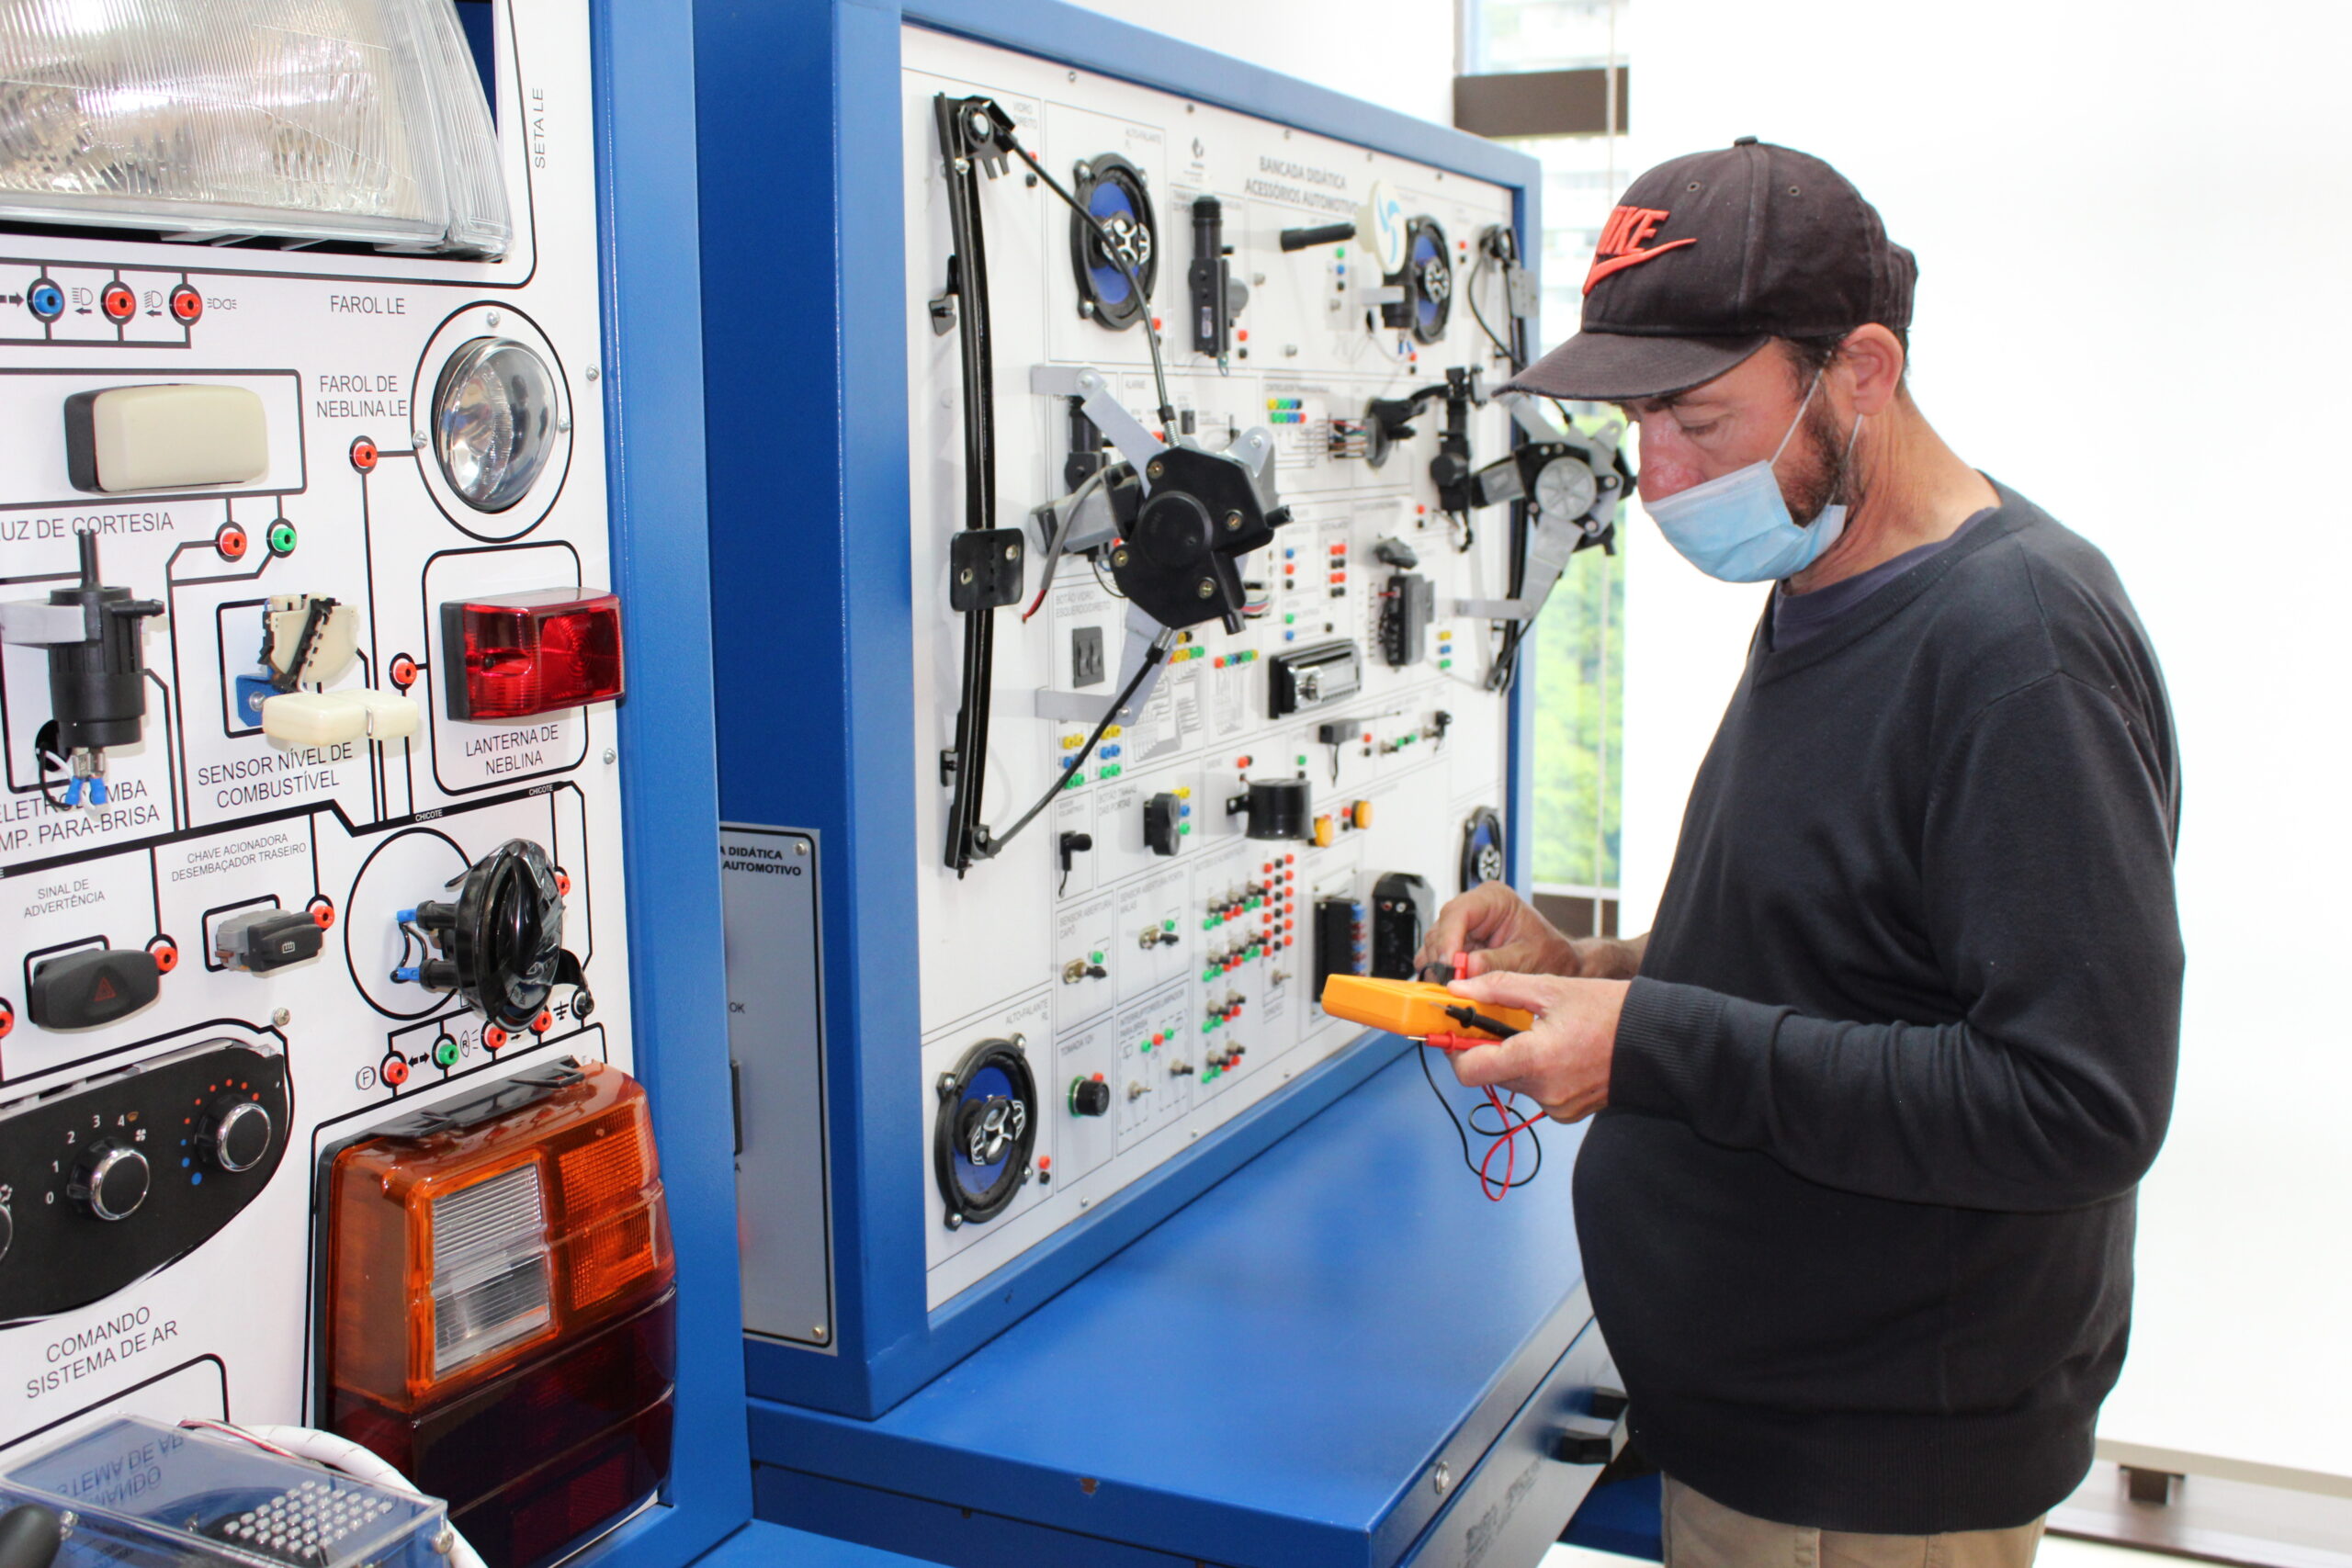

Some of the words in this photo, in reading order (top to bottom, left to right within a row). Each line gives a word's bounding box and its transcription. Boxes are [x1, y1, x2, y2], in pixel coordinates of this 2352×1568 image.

[532, 88, 544, 112] LE
[534, 118, 546, 168] SETA
[1260, 155, 1304, 179] BANCADA
[1303, 190, 1359, 213] AUTOMOTIVO
[330, 295, 383, 314] FAROL
[387, 297, 406, 315] LE
[320, 375, 372, 393] FAROL
[377, 375, 398, 392] DE
[316, 400, 386, 418] NEBLINA
[390, 400, 408, 416] LE
[0, 521, 30, 542] UZ
[37, 518, 65, 543] DE
[72, 512, 175, 536] CORTESIA
[466, 728, 538, 757] LANTERNA
[541, 724, 560, 742] DE
[198, 756, 274, 786] SENSOR
[277, 746, 327, 772] NÍVEL
[331, 741, 353, 761] DE
[485, 750, 544, 776] NEBLINA
[217, 769, 340, 808] COMBUSTÍVEL
[528, 784, 554, 796] CHICOTE
[415, 808, 443, 822] CHICOTE
[0, 829, 31, 853] MP.
[39, 804, 161, 845] PARA-BRISA
[187, 846, 221, 864] CHAVE
[223, 833, 288, 854] ACIONADORA
[729, 846, 783, 861] DIDÁTICA
[171, 852, 256, 882] DESEMBAÇADOR
[258, 842, 307, 862] TRASEIRO
[722, 860, 802, 876] AUTOMOTIVO
[38, 883, 71, 900] SINAL
[74, 878, 90, 893] DE
[24, 890, 106, 919] ADVERTÊNCIA
[93, 1114, 101, 1128] 3
[117, 1114, 125, 1127] 4
[67, 1130, 75, 1145] 2
[51, 1160, 60, 1173] 1
[46, 1190, 54, 1204] 0
[46, 1306, 151, 1363] COMANDO
[26, 1348, 118, 1399] SISTEMA
[120, 1332, 148, 1359] DE
[152, 1320, 178, 1347] AR
